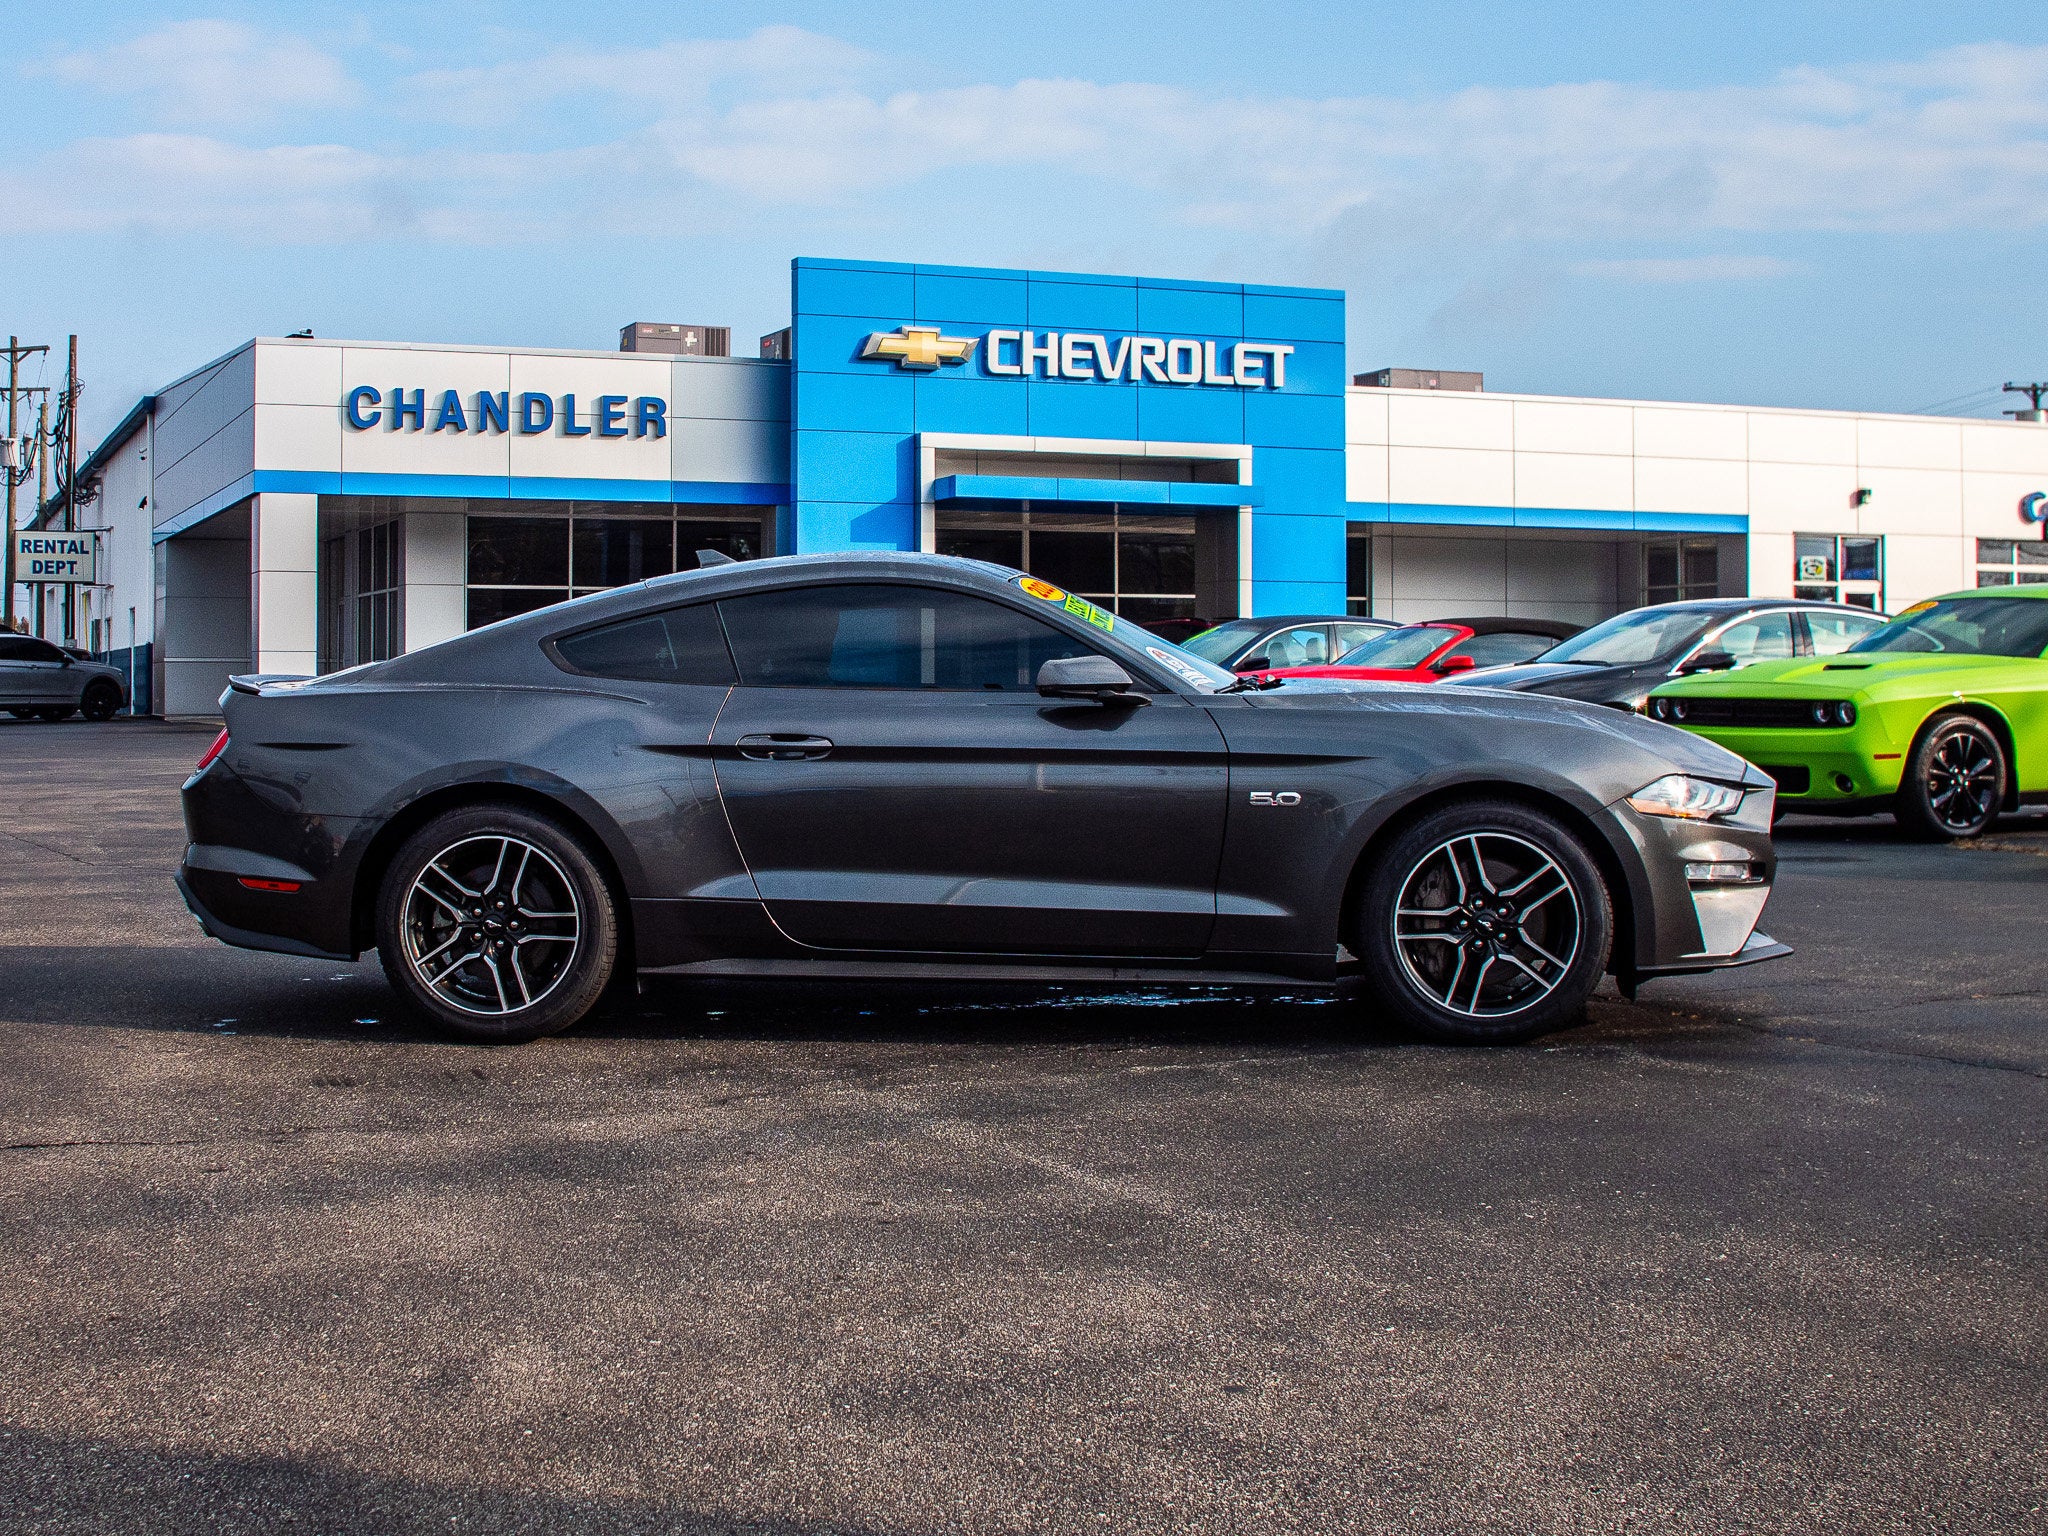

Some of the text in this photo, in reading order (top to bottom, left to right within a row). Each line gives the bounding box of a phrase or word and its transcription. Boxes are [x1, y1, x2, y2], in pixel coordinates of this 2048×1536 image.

[986, 328, 1295, 388] CHEVROLET
[348, 384, 668, 438] CHANDLER
[20, 538, 90, 554] RENTAL
[31, 559, 78, 575] DEPT.
[1249, 791, 1302, 806] 5.0
